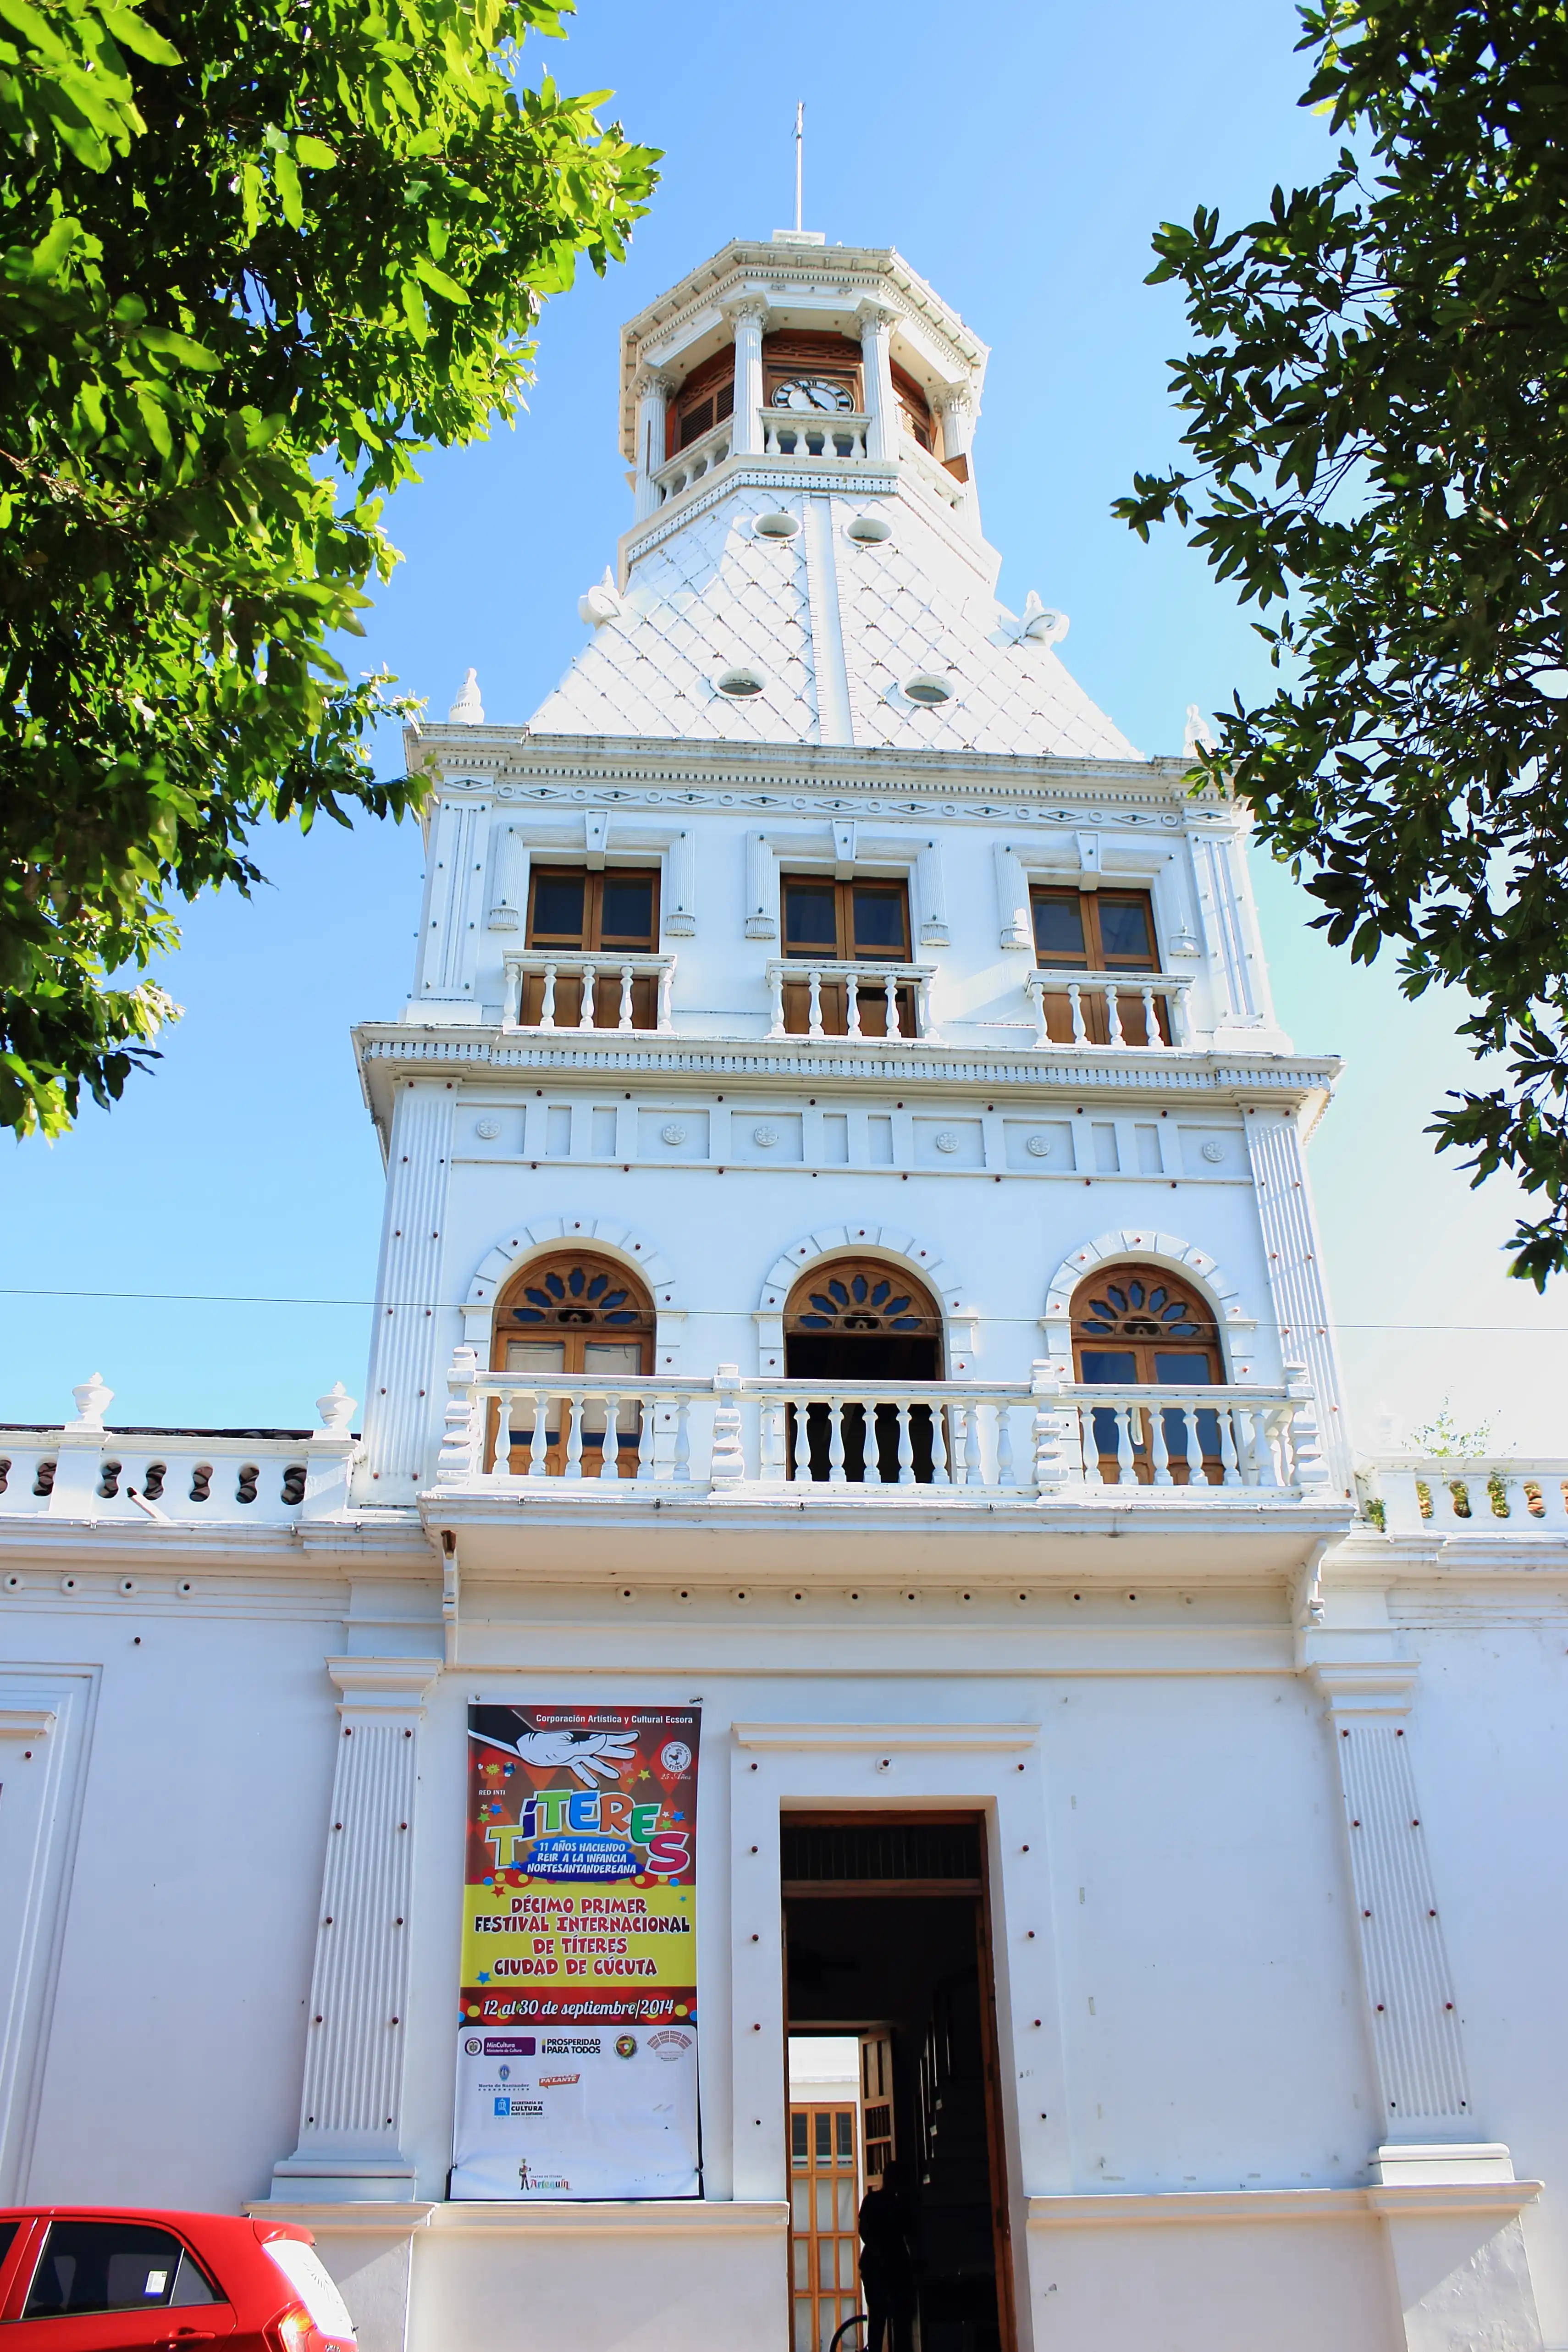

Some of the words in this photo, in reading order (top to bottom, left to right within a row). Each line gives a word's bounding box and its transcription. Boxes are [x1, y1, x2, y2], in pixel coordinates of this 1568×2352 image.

[536, 1714, 585, 1723] Corporación
[540, 1842, 548, 1851] 11
[552, 1840, 577, 1851] AÑOS
[580, 1843, 625, 1852] HACIENDO
[537, 1853, 558, 1862] REIR
[562, 1854, 569, 1862] A
[572, 1854, 584, 1862] LA
[587, 1854, 627, 1863] INFANCIA
[527, 1863, 636, 1873] NORTESANTANDEREANA
[511, 1894, 574, 1914] DÉCIMO
[581, 1898, 647, 1914] PRIMER
[475, 1915, 549, 1933] FESTIVAL
[556, 1915, 690, 1933] INTERNACIONAL
[532, 1938, 554, 1955] DE
[561, 1934, 627, 1954] TÍTERES
[494, 1958, 559, 1976] CIUDAD
[566, 1958, 587, 1976] DE
[593, 1955, 658, 1976] CÚCUTA
[484, 2000, 498, 2015] 12
[502, 2001, 516, 2015] al
[519, 1999, 539, 2015] 30
[541, 2001, 558, 2015] de
